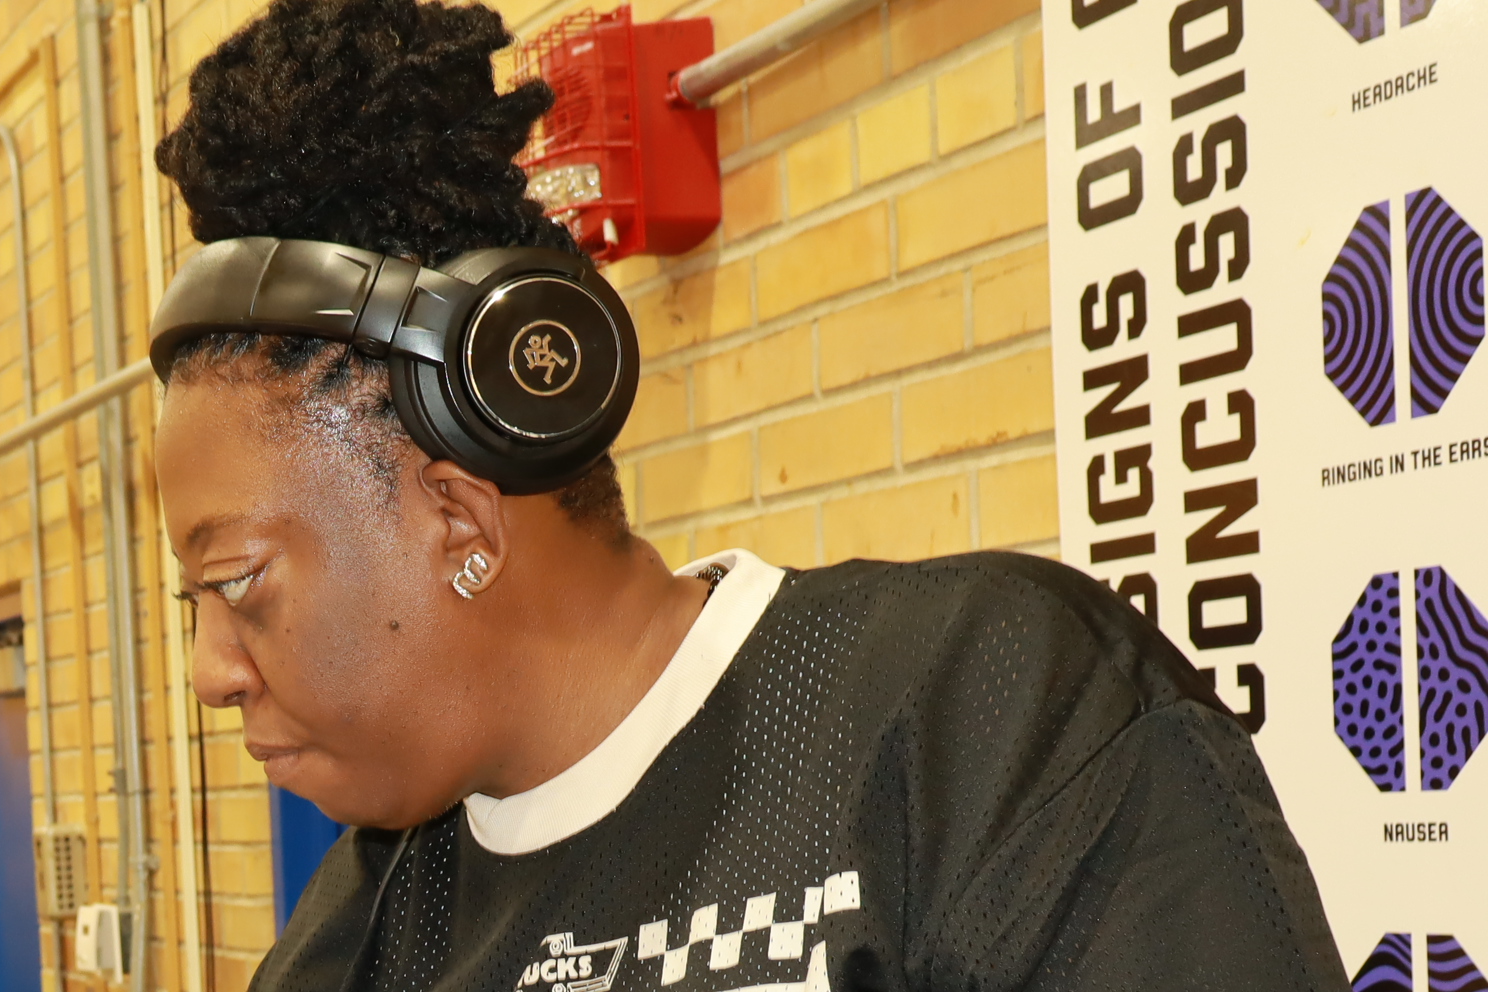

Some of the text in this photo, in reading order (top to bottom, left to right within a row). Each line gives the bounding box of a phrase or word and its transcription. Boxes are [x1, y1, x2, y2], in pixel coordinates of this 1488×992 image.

[1351, 61, 1439, 113] HEADACHE
[1074, 80, 1144, 232] OF
[1321, 456, 1385, 488] RINGING
[1388, 451, 1406, 475] IN
[1410, 444, 1443, 471] THE
[1383, 821, 1450, 843] NAUSEA
[517, 954, 593, 988] UCKS
